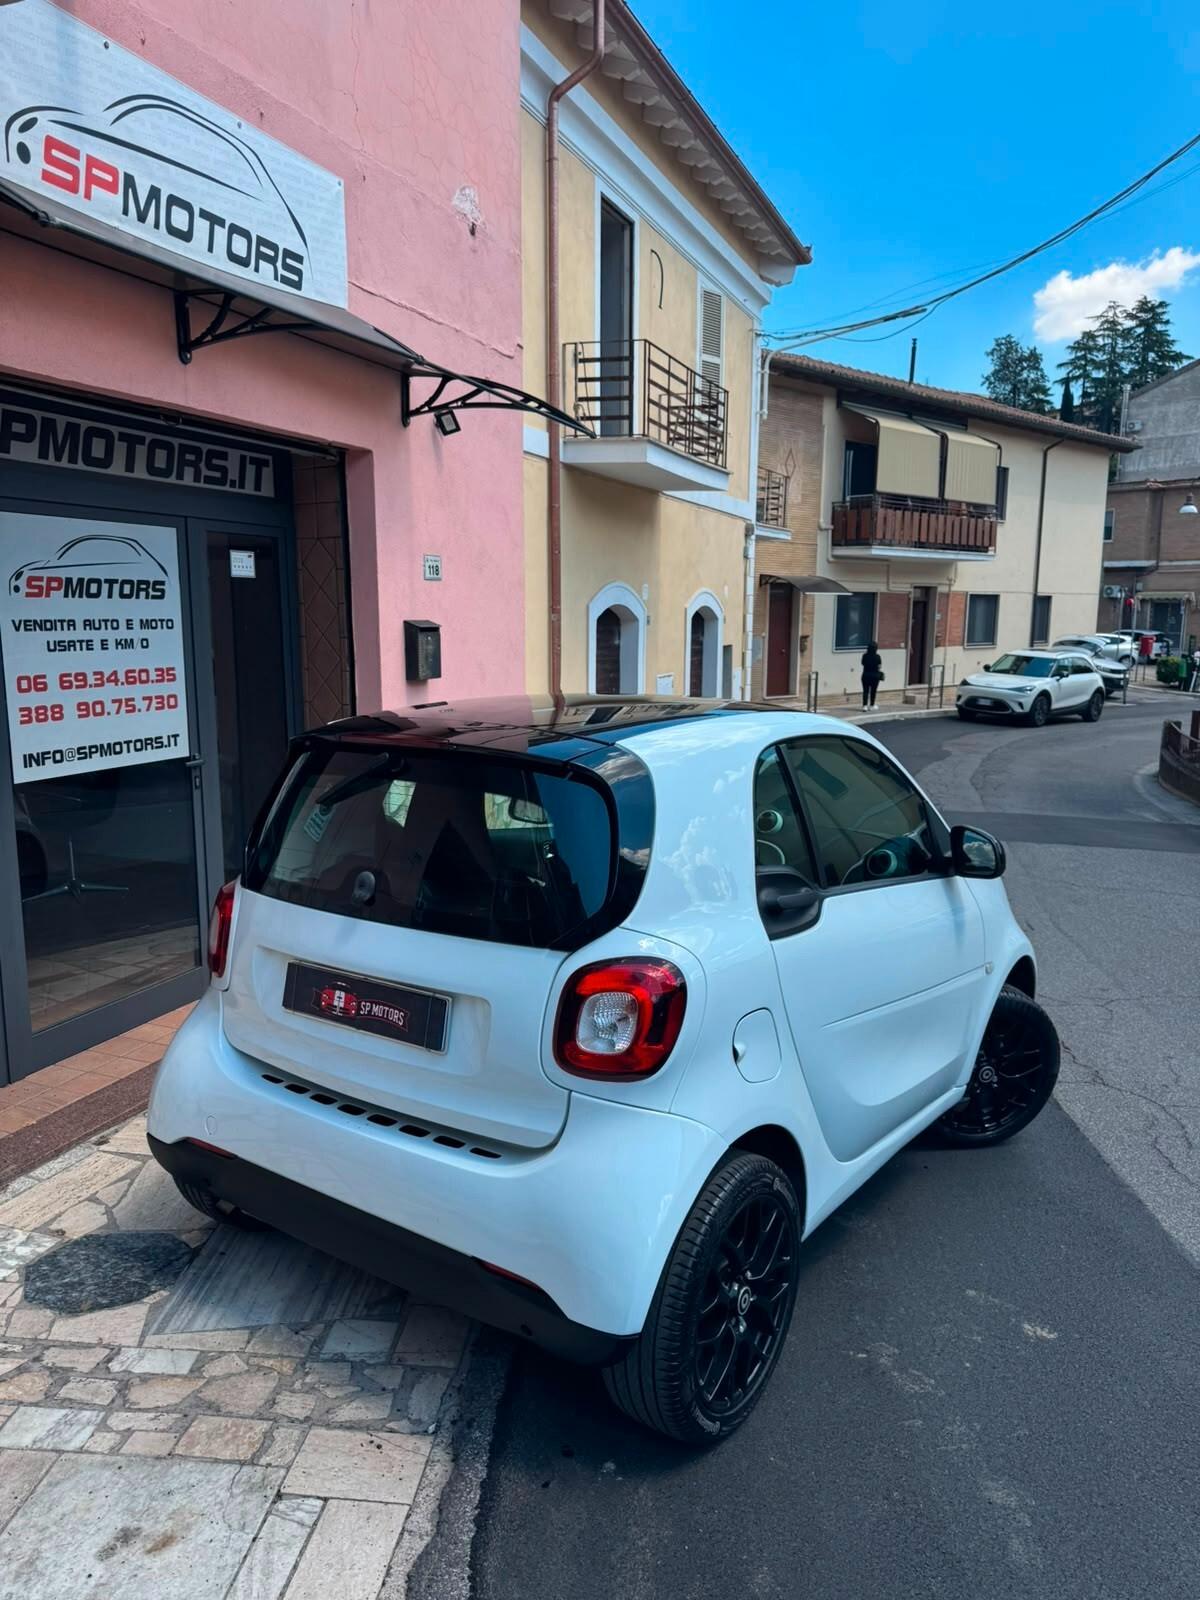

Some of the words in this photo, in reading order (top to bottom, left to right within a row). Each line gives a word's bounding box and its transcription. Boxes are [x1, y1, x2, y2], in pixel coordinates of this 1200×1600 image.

[41, 133, 304, 291] SPMOTORS
[427, 564, 440, 576] 118
[25, 575, 166, 600] SPMOTORS
[11, 619, 77, 632] VENDITA
[83, 619, 120, 631] AUTO
[126, 618, 134, 630] E
[139, 618, 175, 630] MOTO
[46, 639, 94, 652] USATE
[100, 639, 109, 650] E
[16, 674, 48, 694] 06
[58, 666, 177, 691] 69.34.60.35
[18, 703, 65, 725] 388
[76, 693, 178, 719] 90.75.730
[23, 733, 181, 768] INFO@SPMOTORS.IT
[360, 1001, 371, 1015] SP
[371, 1003, 405, 1026] MOTORS
